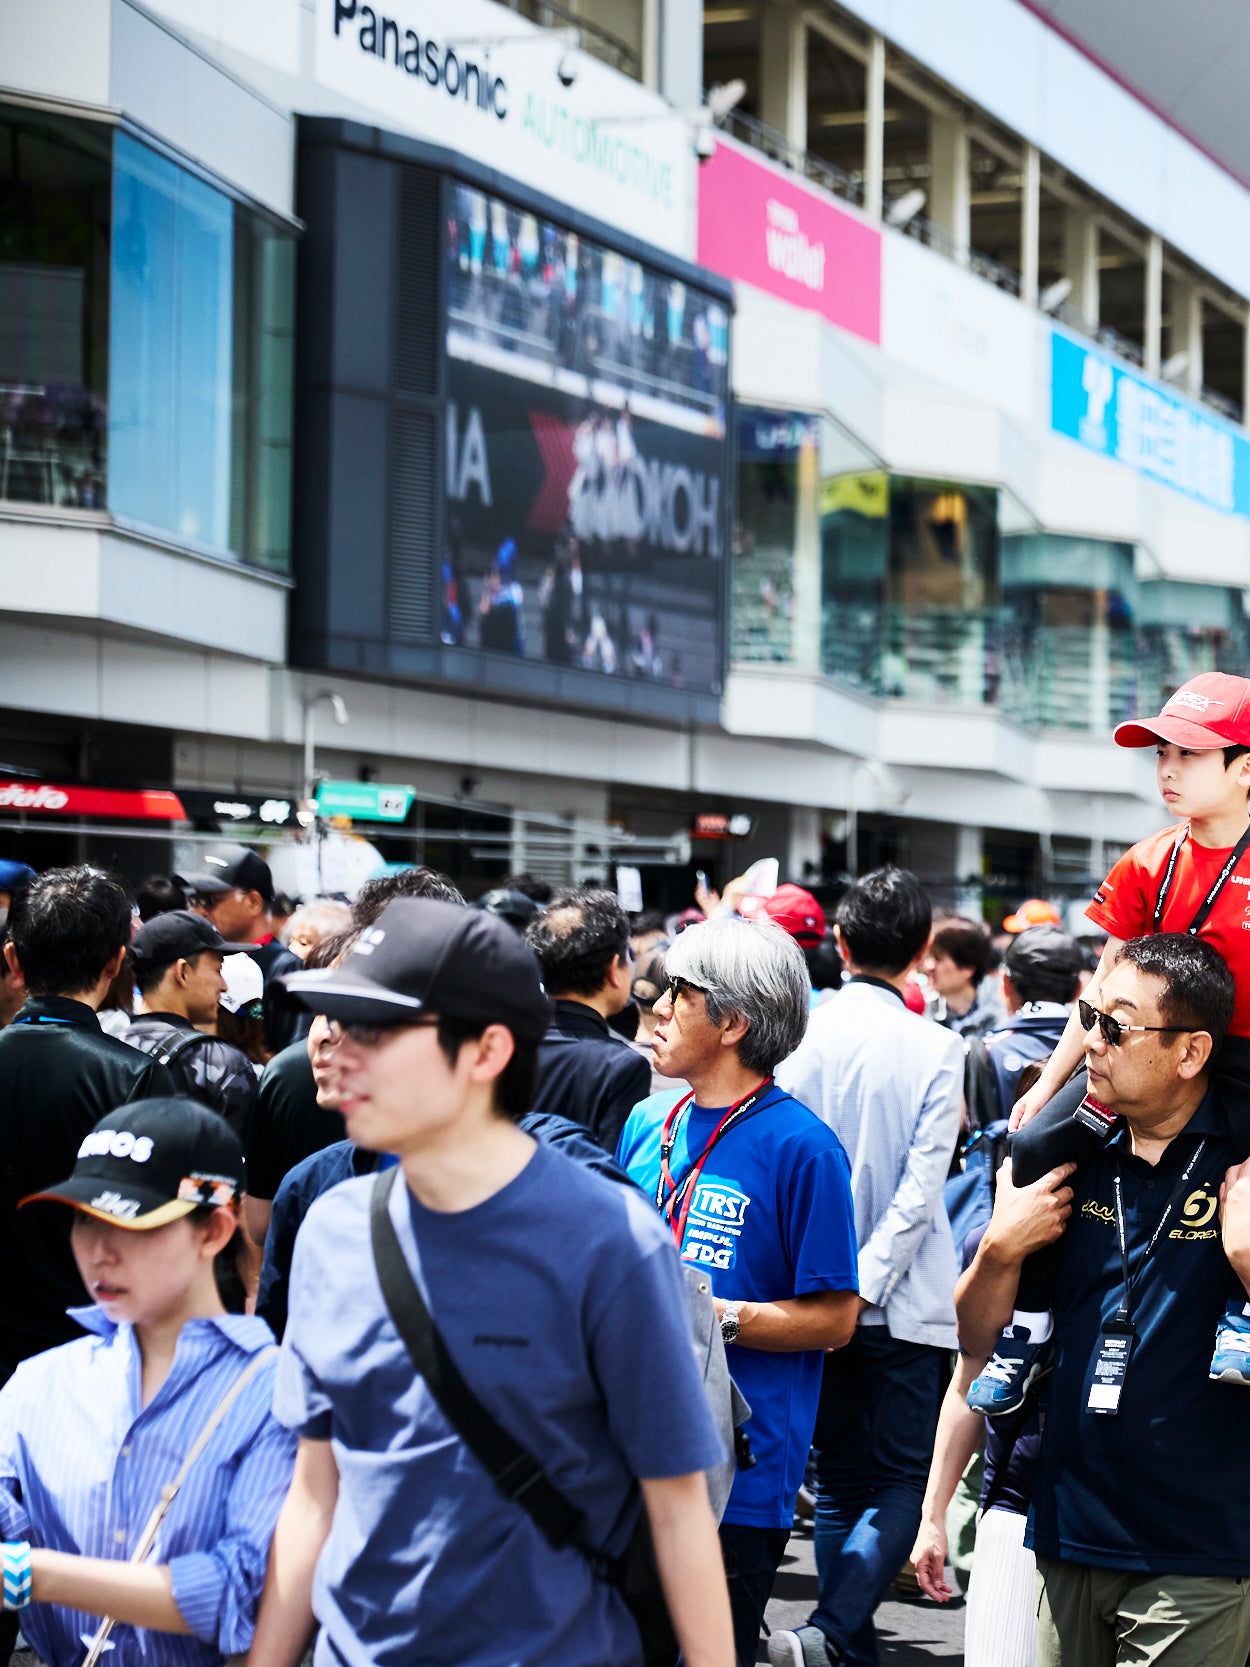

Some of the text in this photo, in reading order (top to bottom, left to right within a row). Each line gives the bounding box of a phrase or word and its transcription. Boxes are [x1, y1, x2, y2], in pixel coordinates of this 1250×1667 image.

[334, 0, 676, 208] Panasonic AUTOMOTIVE
[700, 1189, 741, 1219] TRS
[687, 1228, 734, 1248] IMPUL
[681, 1241, 734, 1269] SDG
